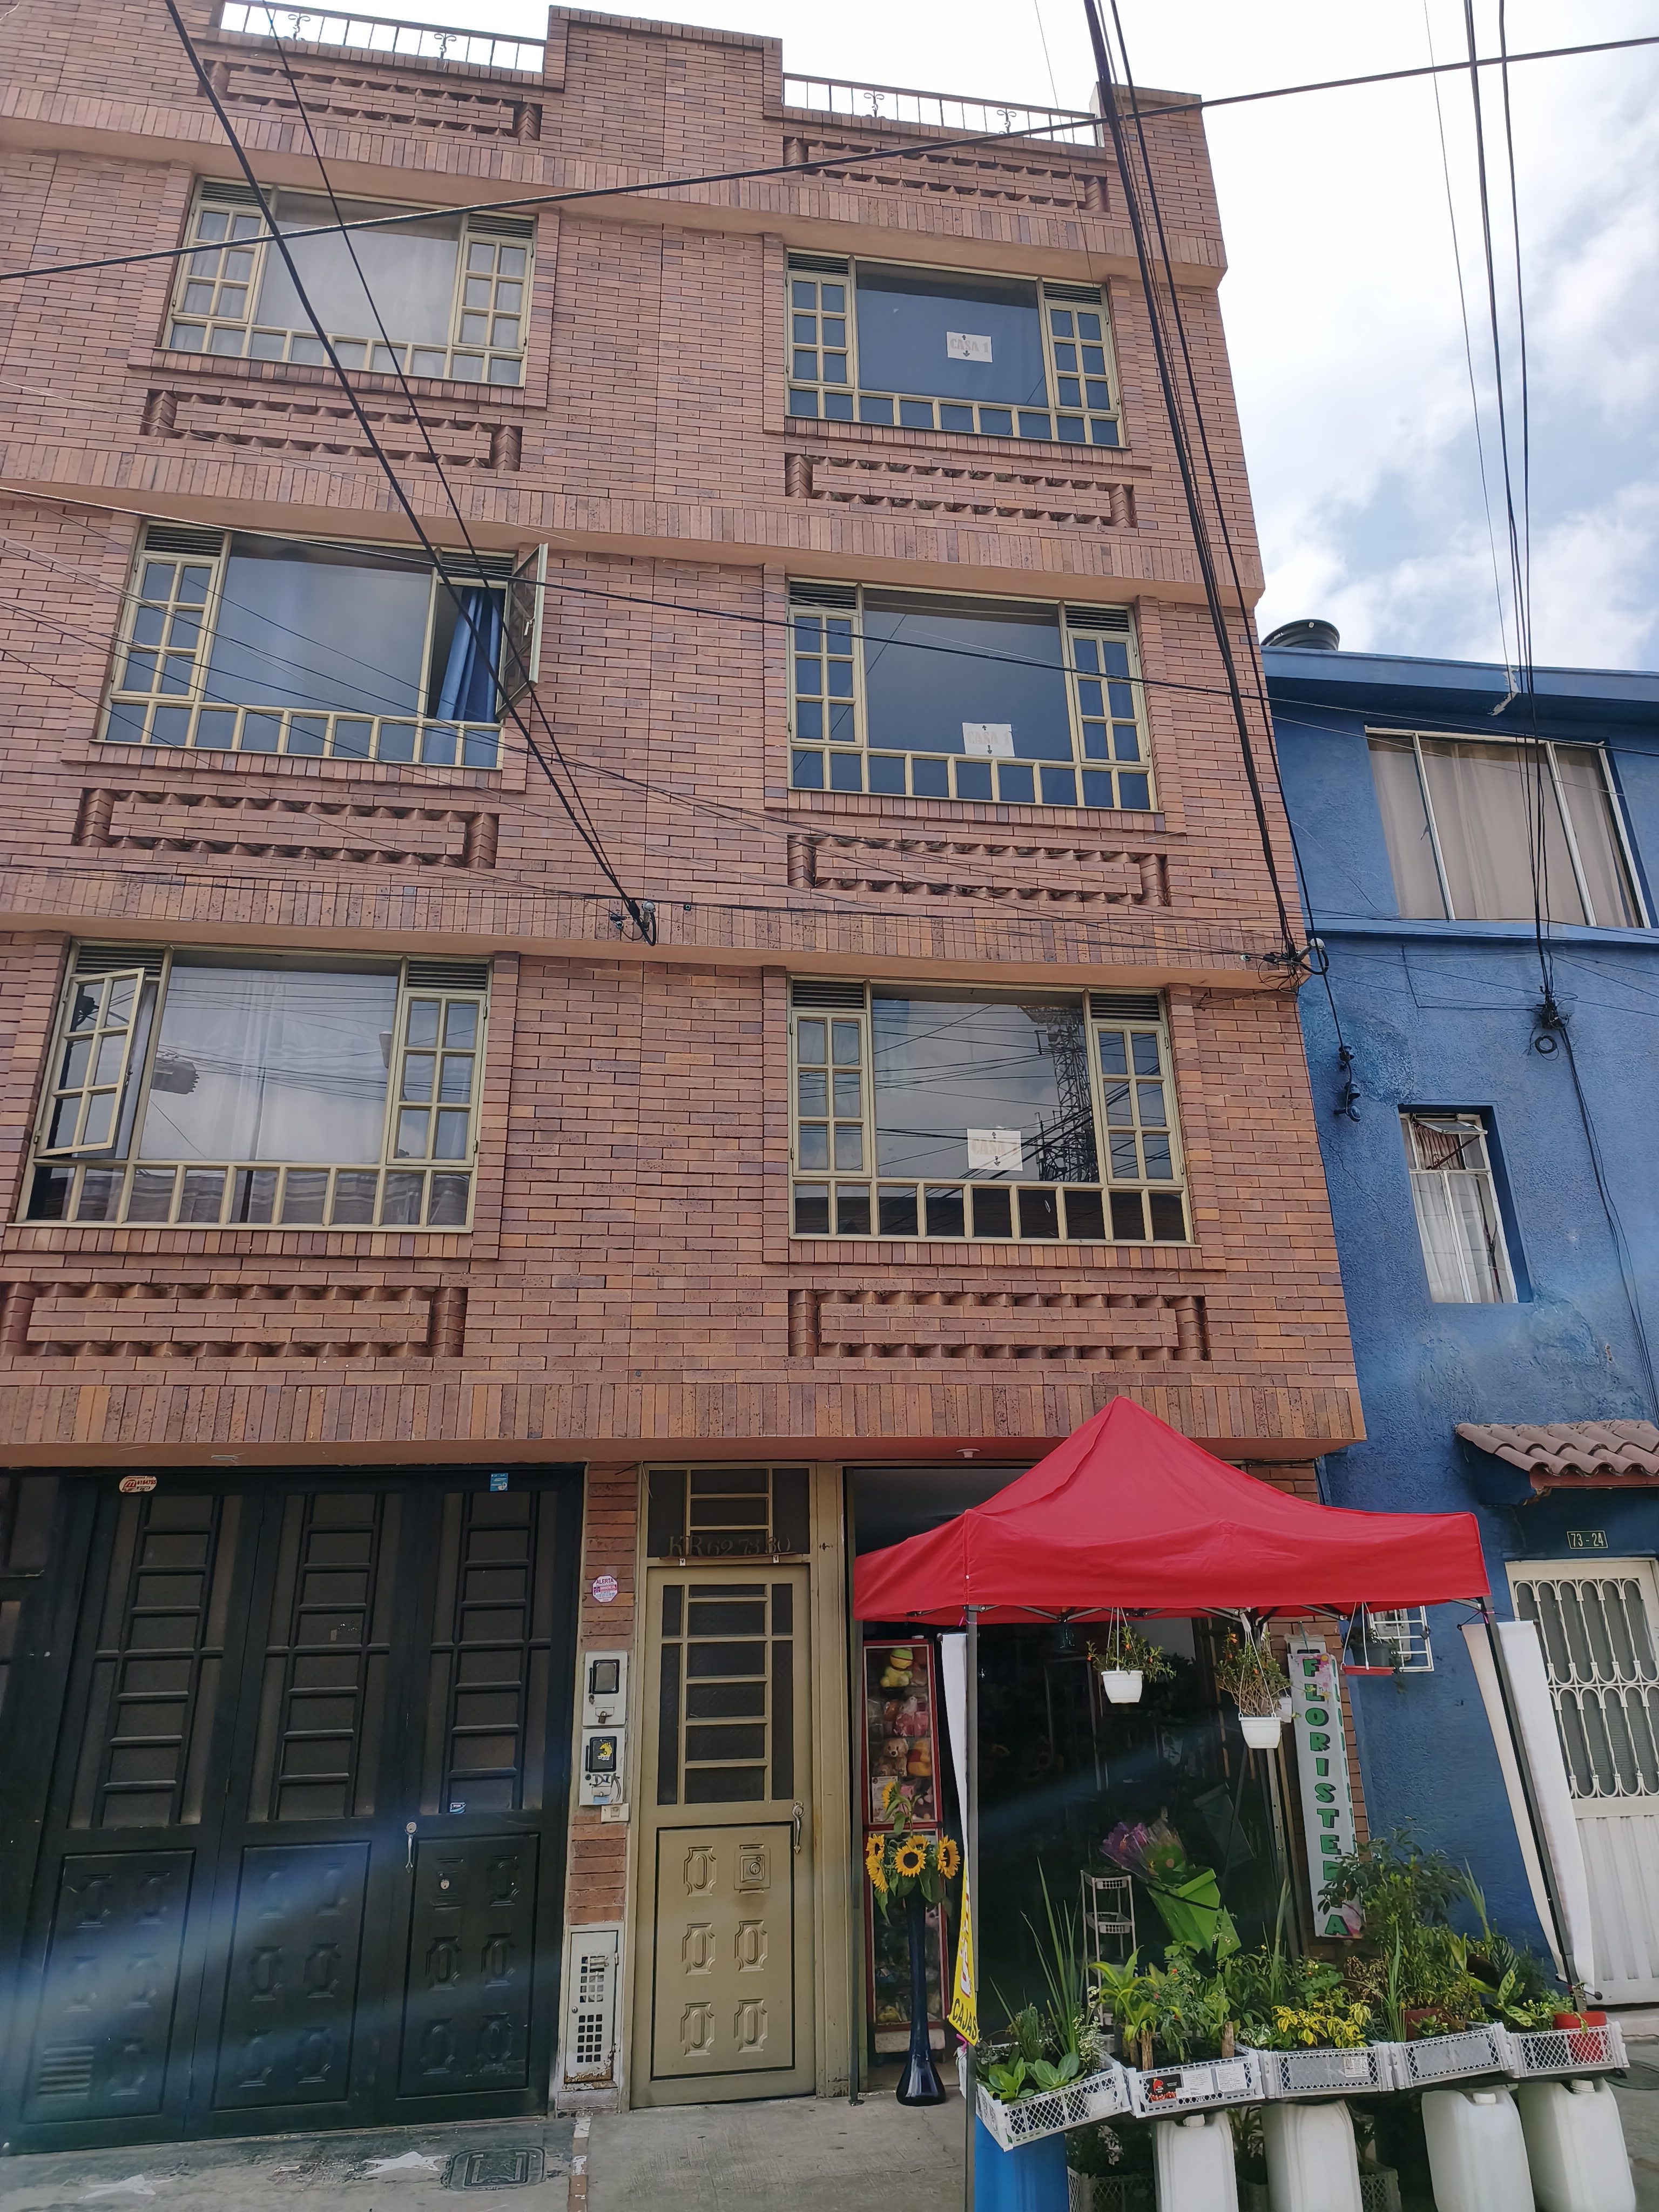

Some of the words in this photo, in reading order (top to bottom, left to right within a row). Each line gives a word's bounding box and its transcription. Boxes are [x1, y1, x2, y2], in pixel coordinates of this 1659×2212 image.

[949, 338, 979, 352] CASA
[983, 342, 989, 353] 1
[967, 731, 999, 745] CASA
[971, 1139, 1006, 1155] CASA
[669, 1535, 705, 1557] KR
[707, 1539, 733, 1556] 62
[1303, 1658, 1353, 1936] FLORISTERA
[952, 1998, 977, 2040] CAJAS
